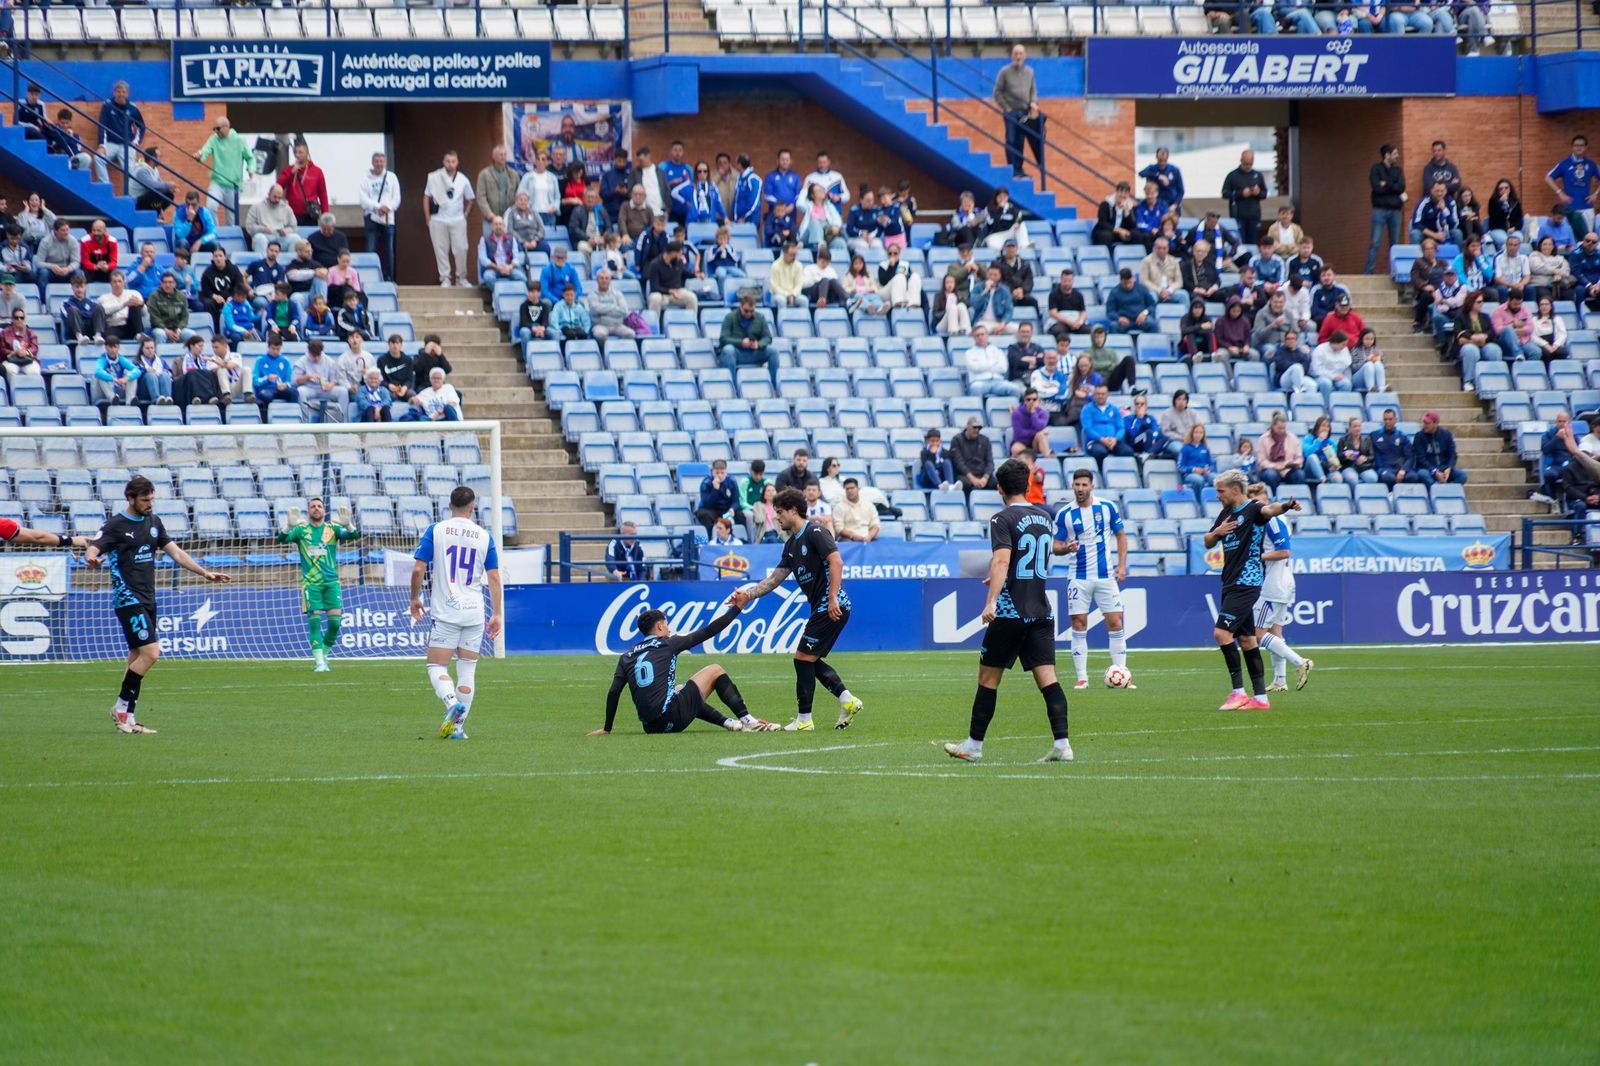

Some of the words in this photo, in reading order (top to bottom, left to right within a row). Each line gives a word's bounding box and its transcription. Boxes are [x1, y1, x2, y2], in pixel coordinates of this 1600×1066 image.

[1178, 40, 1259, 55] Autoescuela
[203, 59, 231, 80] LA
[235, 58, 301, 81] PLAZA
[342, 52, 431, 72] Auténtic@s
[433, 53, 479, 72] pollos
[480, 55, 491, 72] y
[495, 52, 541, 71] pollas
[1173, 54, 1369, 84] GILABERT
[233, 78, 299, 88] ANTILLA
[341, 73, 362, 88] de
[364, 73, 429, 92] Portugal
[433, 73, 449, 89] al
[451, 72, 507, 89] carbón
[1176, 84, 1233, 95] FORMACIÓN
[1240, 85, 1265, 95] Curso
[1266, 85, 1324, 96] Recuperación
[1325, 84, 1336, 95] de
[1337, 84, 1367, 94] Puntos
[446, 527, 459, 536] DEL
[446, 545, 477, 586] 14
[1016, 533, 1052, 580] 20
[1310, 556, 1446, 573] RECREATIVISTA
[1475, 576, 1544, 588] DESDE
[130, 614, 148, 633] 21
[341, 608, 397, 628] alter
[634, 651, 654, 687] 6
